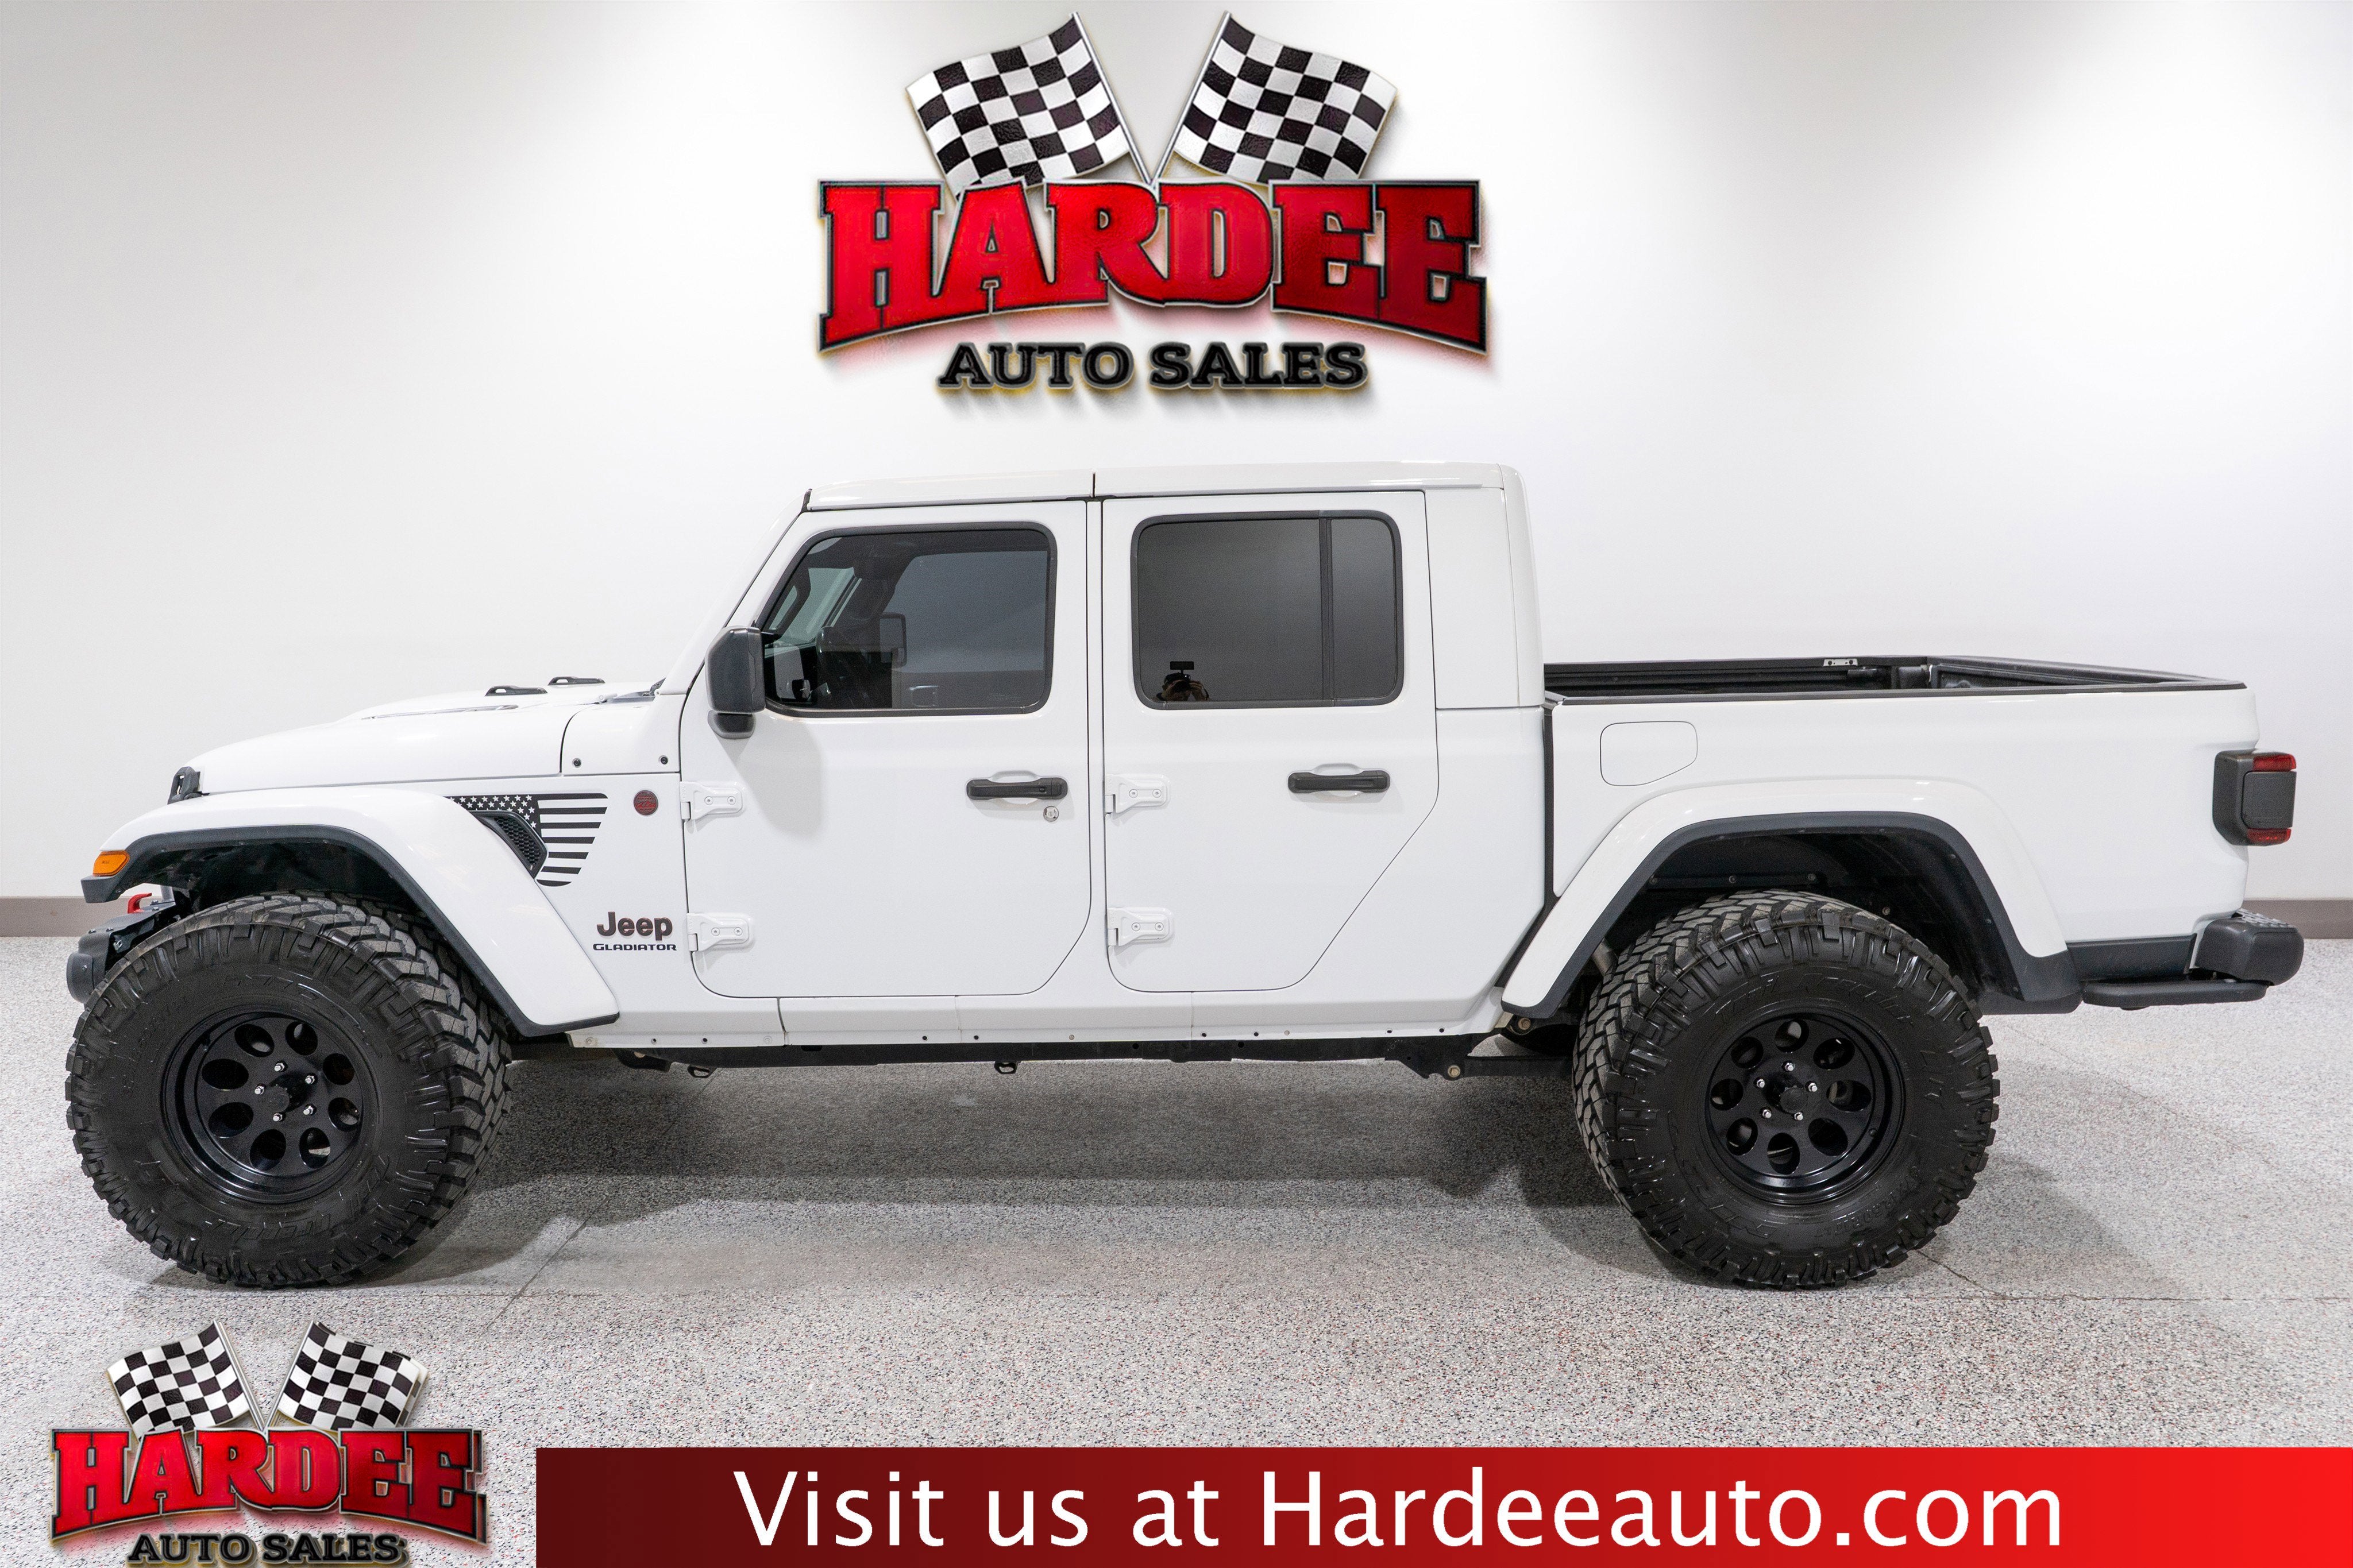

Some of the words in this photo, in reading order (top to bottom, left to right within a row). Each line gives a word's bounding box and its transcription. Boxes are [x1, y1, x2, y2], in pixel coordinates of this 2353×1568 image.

[819, 180, 1488, 353] HARDEE
[938, 343, 1134, 387] AUTO
[1149, 343, 1367, 387] SALES
[596, 912, 673, 941] Jeep
[592, 943, 677, 951] GLADIATOR
